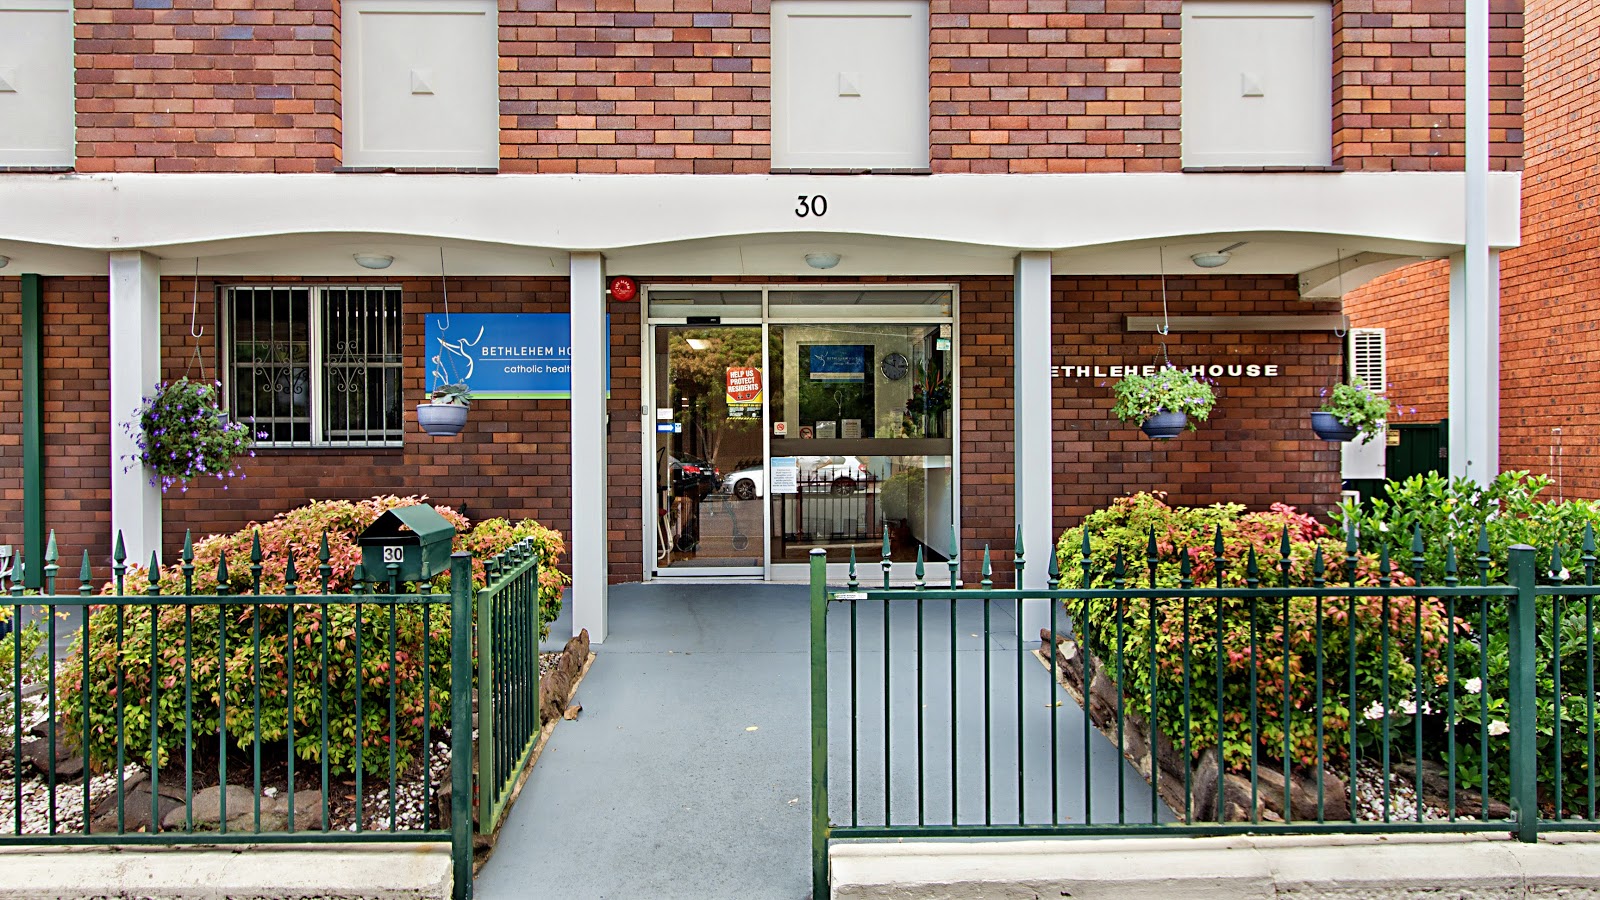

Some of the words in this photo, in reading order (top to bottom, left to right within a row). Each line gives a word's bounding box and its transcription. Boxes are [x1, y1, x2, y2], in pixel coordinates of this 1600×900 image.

[794, 194, 828, 218] 30
[481, 346, 554, 356] BETHLEHEM
[503, 364, 543, 374] catholic
[1191, 364, 1279, 377] HOUSE
[730, 371, 745, 379] HELP
[730, 377, 755, 385] PROTECT
[728, 383, 759, 392] RESIDENTS
[384, 547, 403, 561] 30
